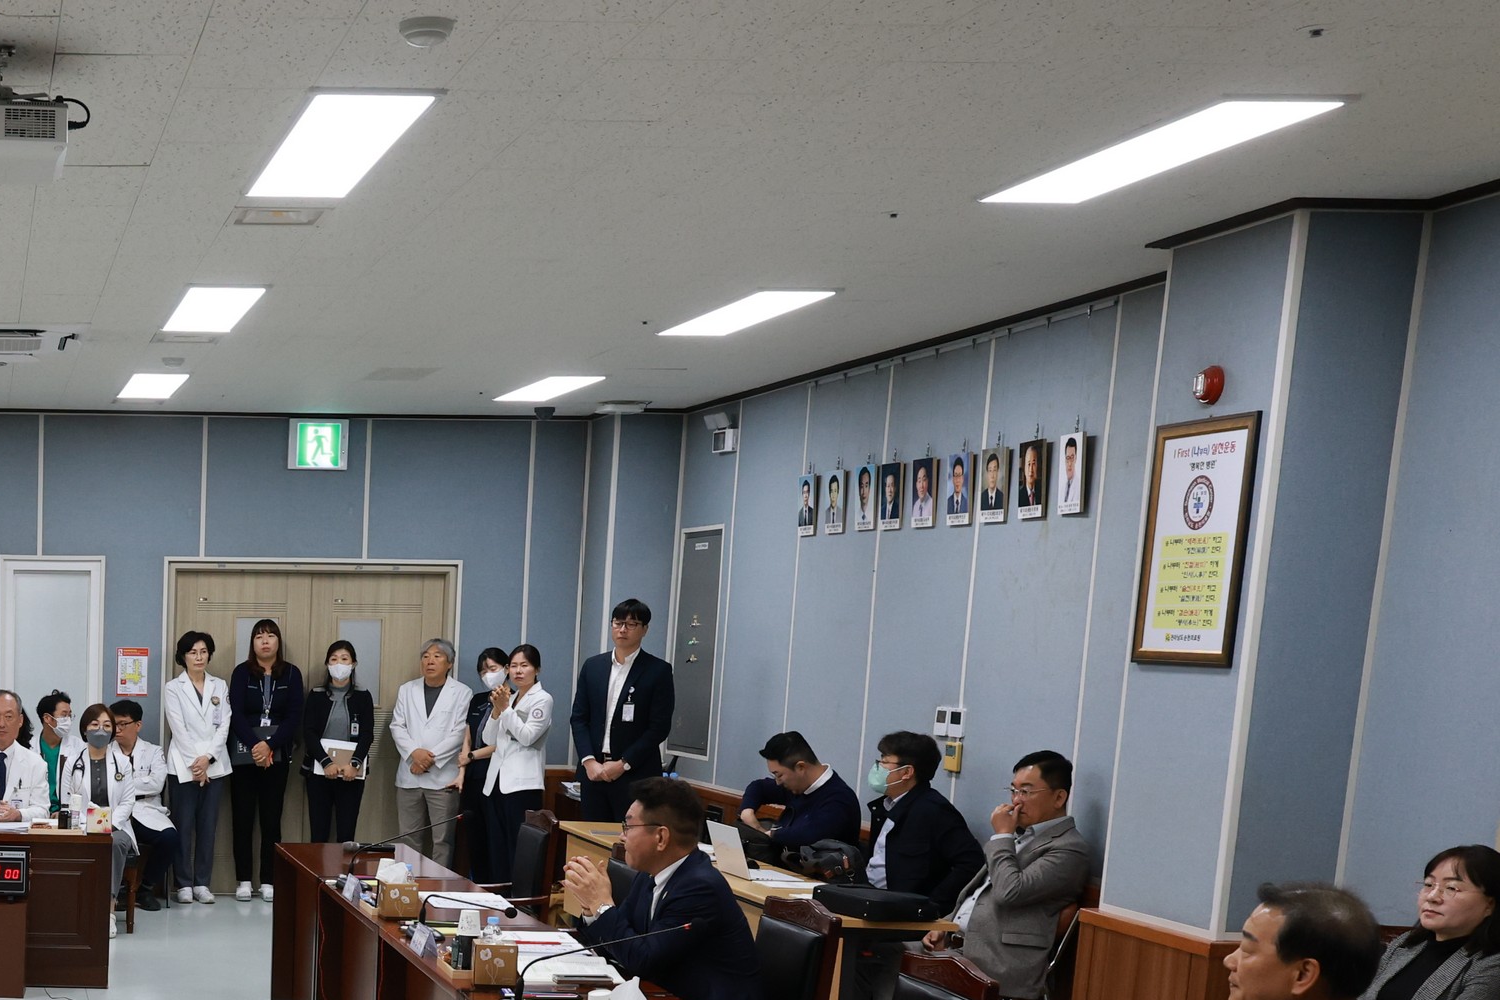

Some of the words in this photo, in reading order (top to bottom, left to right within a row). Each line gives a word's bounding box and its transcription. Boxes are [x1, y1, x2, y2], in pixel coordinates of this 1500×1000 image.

[1177, 448, 1190, 458] First
[1211, 441, 1236, 455] 실천운동
[4, 869, 19, 879] 00
